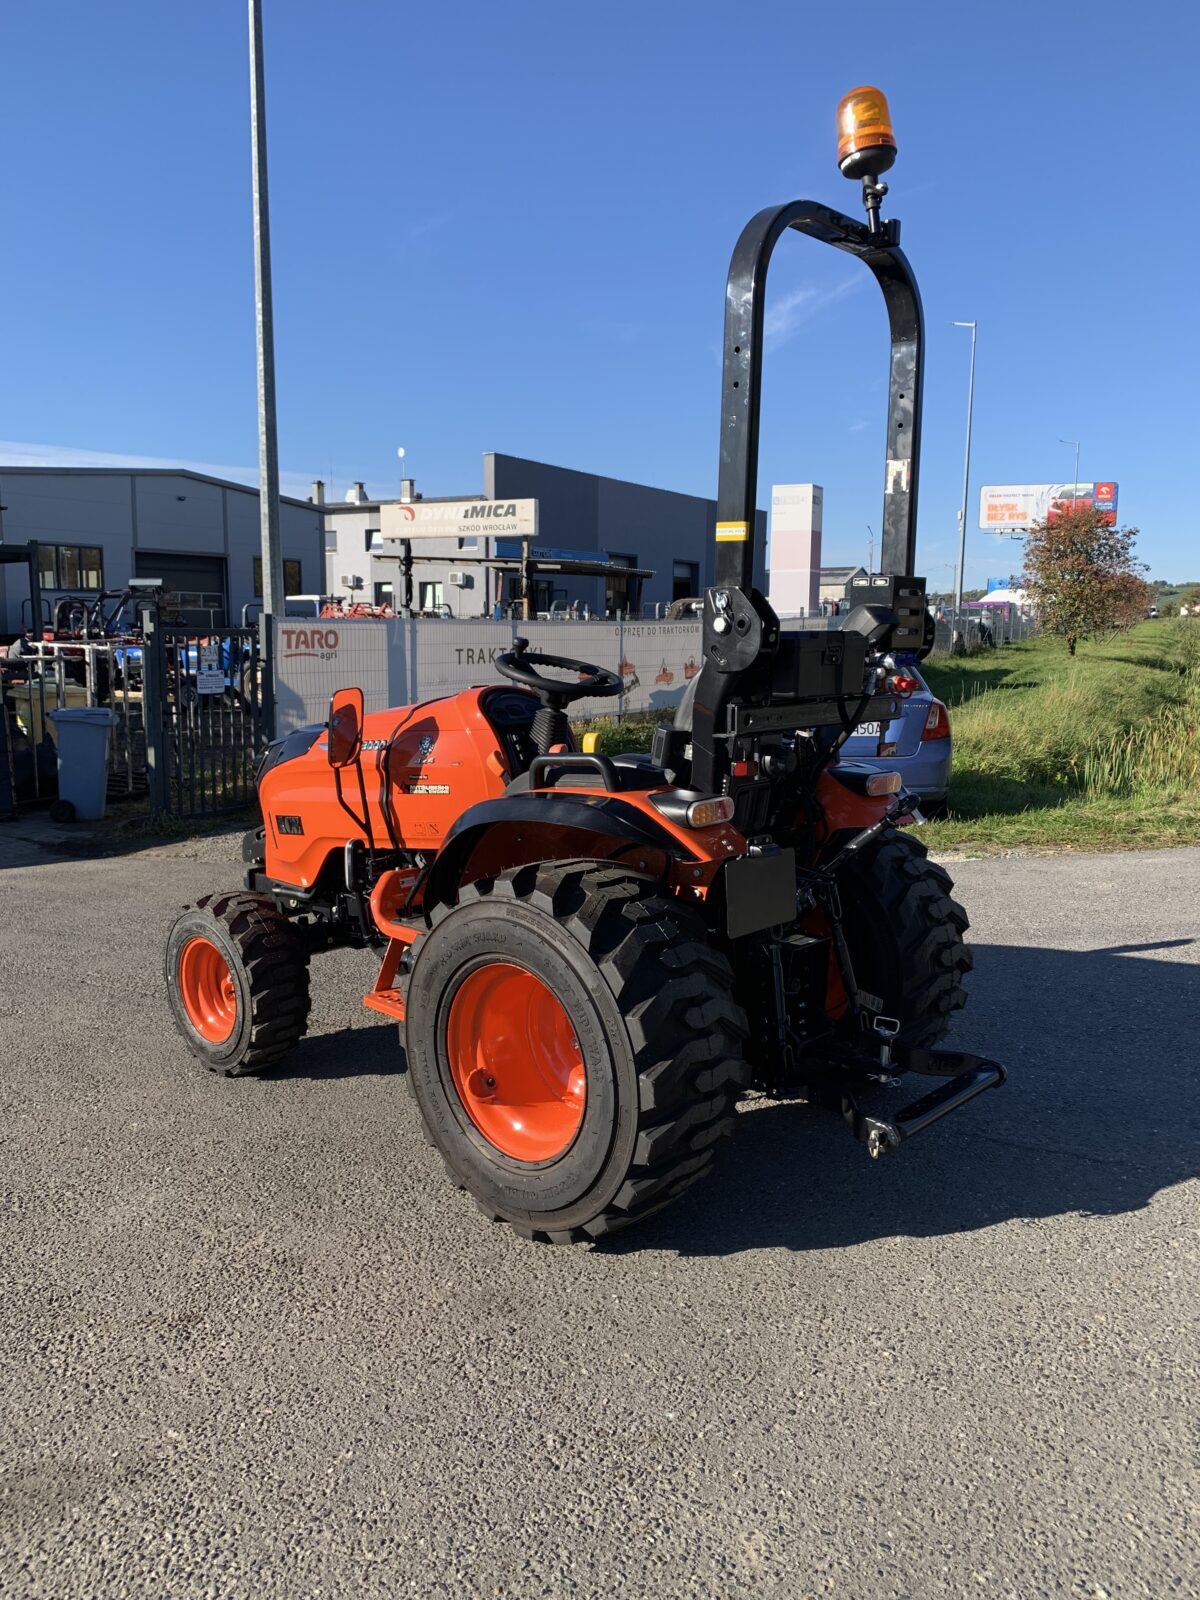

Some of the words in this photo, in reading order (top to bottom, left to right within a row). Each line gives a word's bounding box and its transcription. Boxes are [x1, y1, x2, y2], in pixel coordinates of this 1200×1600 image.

[614, 626, 645, 637] OPRZĘT
[647, 626, 657, 636] DO
[282, 629, 339, 650] TARO
[320, 650, 338, 660] agri
